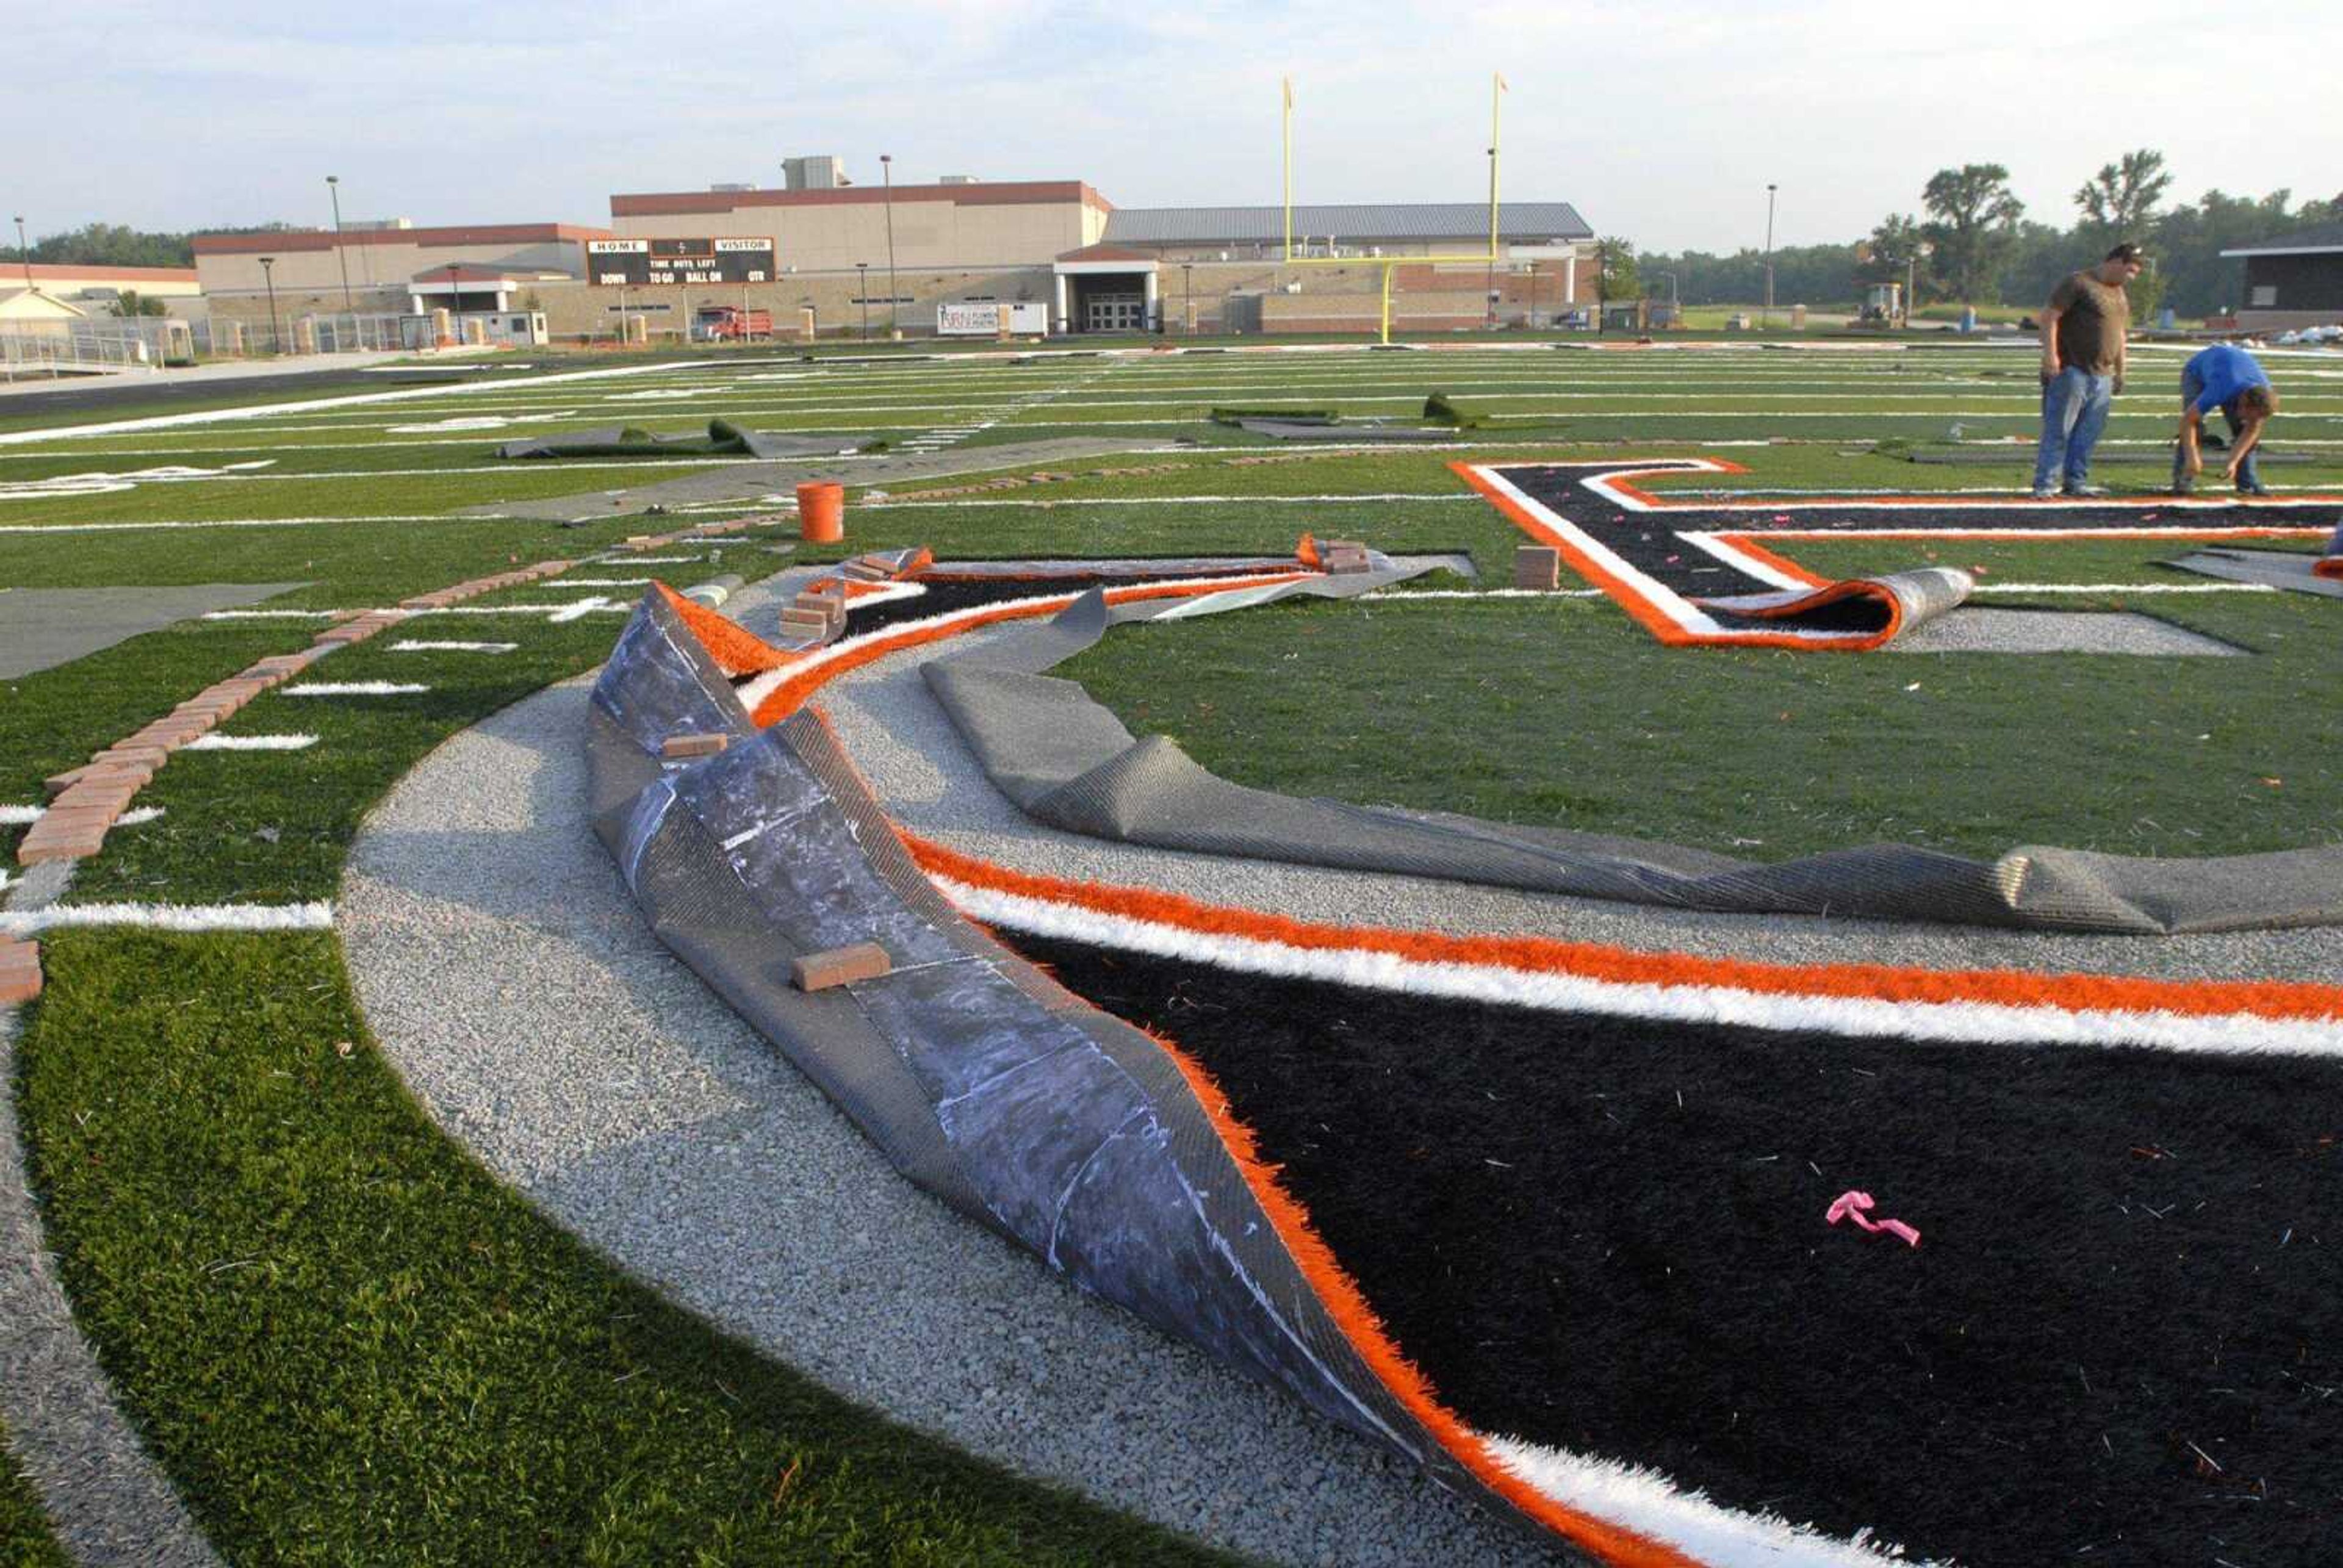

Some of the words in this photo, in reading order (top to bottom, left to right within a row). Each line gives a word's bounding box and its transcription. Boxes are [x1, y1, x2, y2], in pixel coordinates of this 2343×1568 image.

[597, 242, 638, 251] HOME
[721, 241, 766, 250] VISITOR
[697, 259, 715, 267] LEFT
[600, 273, 627, 284] DOWN
[649, 272, 661, 283] TO
[662, 272, 674, 283] GO
[686, 272, 708, 282] BALL
[709, 271, 722, 282] ON
